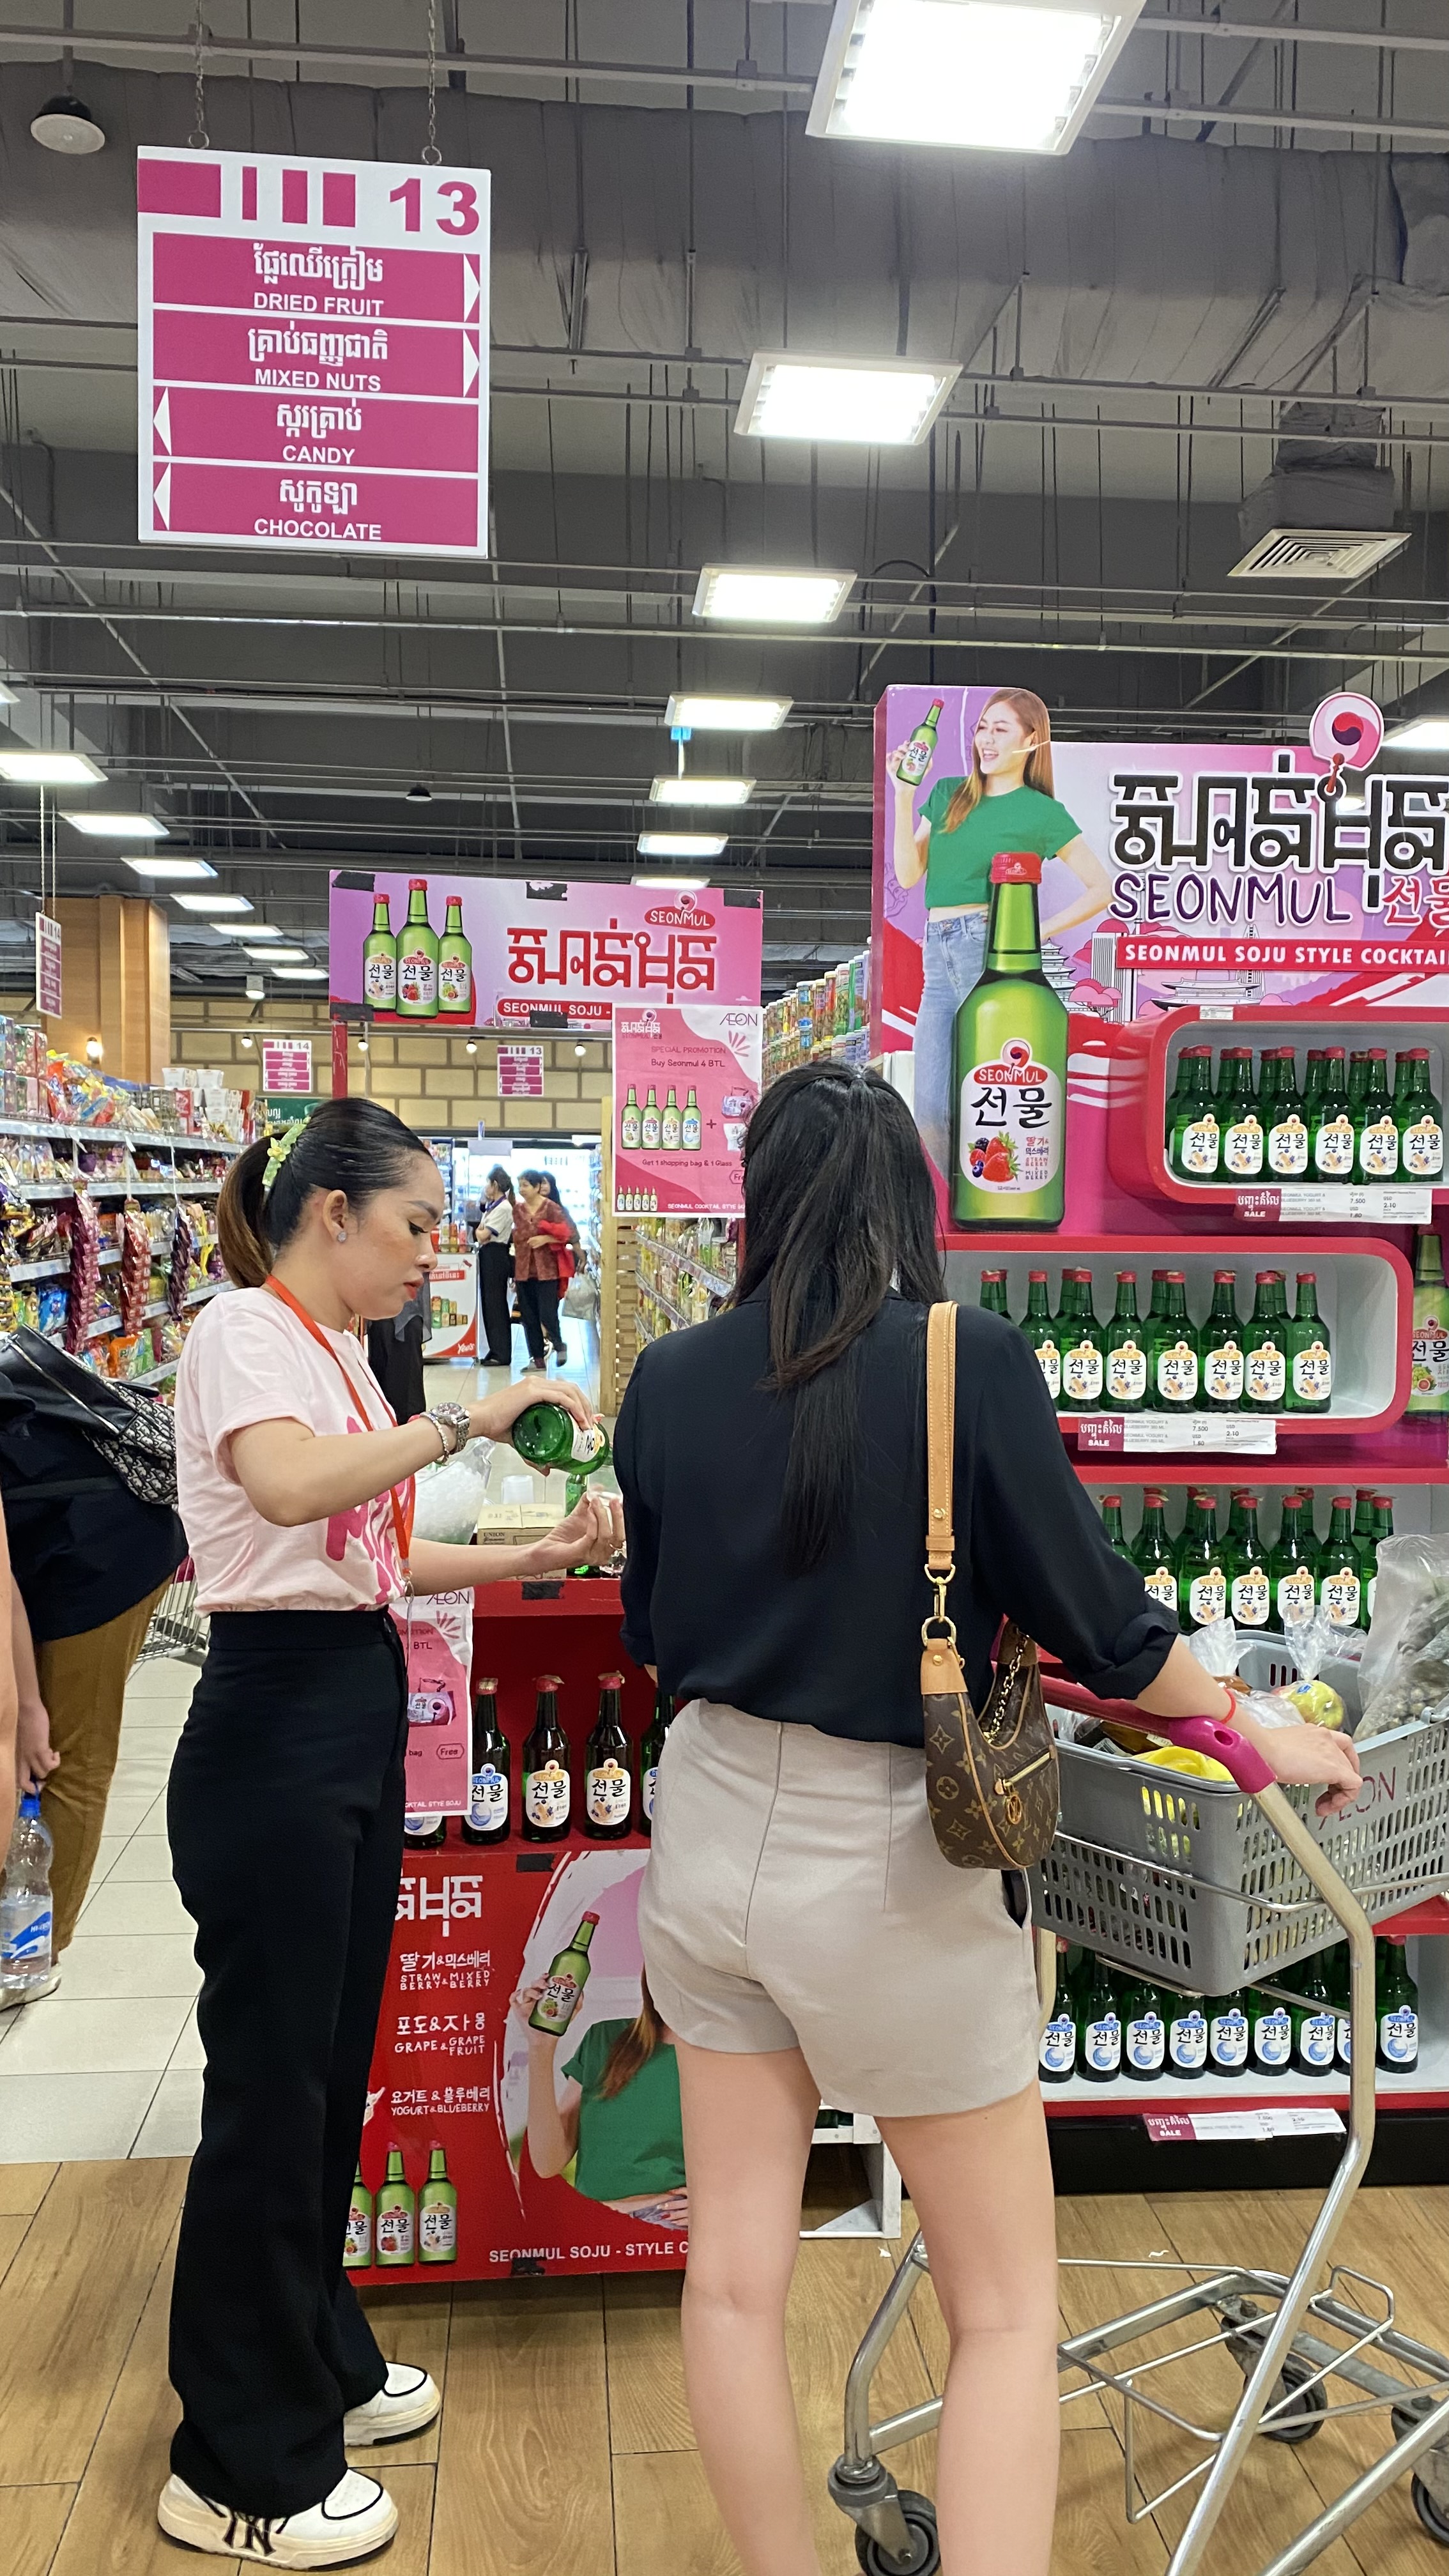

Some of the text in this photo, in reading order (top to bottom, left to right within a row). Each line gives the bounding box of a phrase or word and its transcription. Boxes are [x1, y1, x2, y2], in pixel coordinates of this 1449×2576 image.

[389, 178, 479, 235] 13
[254, 243, 383, 289] ផ្លែឈើក្រៀម
[254, 293, 383, 316] DRIED FRUIT
[248, 321, 387, 366] គ្រាប់ធញ្ញជាតិ
[255, 369, 381, 392] MIXED NUTS
[277, 398, 362, 438] ស្ករគ្រាប់
[283, 446, 355, 464] CANDY
[280, 479, 356, 515] សូកូឡា
[254, 519, 381, 540] CHOCOLATE
[1110, 872, 1350, 924] SEONMUL
[650, 910, 710, 927] SEONMUL
[1125, 944, 1449, 965] SEONMUL SOJU STYLE COCKTAI
[569, 1005, 602, 1016] SOJU
[652, 1059, 664, 1068] Buy
[979, 1068, 1042, 1082] SEONMUL
[401, 1970, 489, 1982] STRAW MIXED
[401, 1981, 440, 1990] BERRY
[450, 1979, 489, 1988] BERRY
[395, 2041, 438, 2053] GRAPE
[449, 2035, 485, 2046] GRAPE
[449, 2045, 484, 2055] FRUIT
[391, 2086, 490, 2103] 요거트 & 블루베리
[489, 2248, 565, 2262] SEONMUL
[570, 2245, 610, 2258] SOJU
[625, 2242, 673, 2256] STYLE
